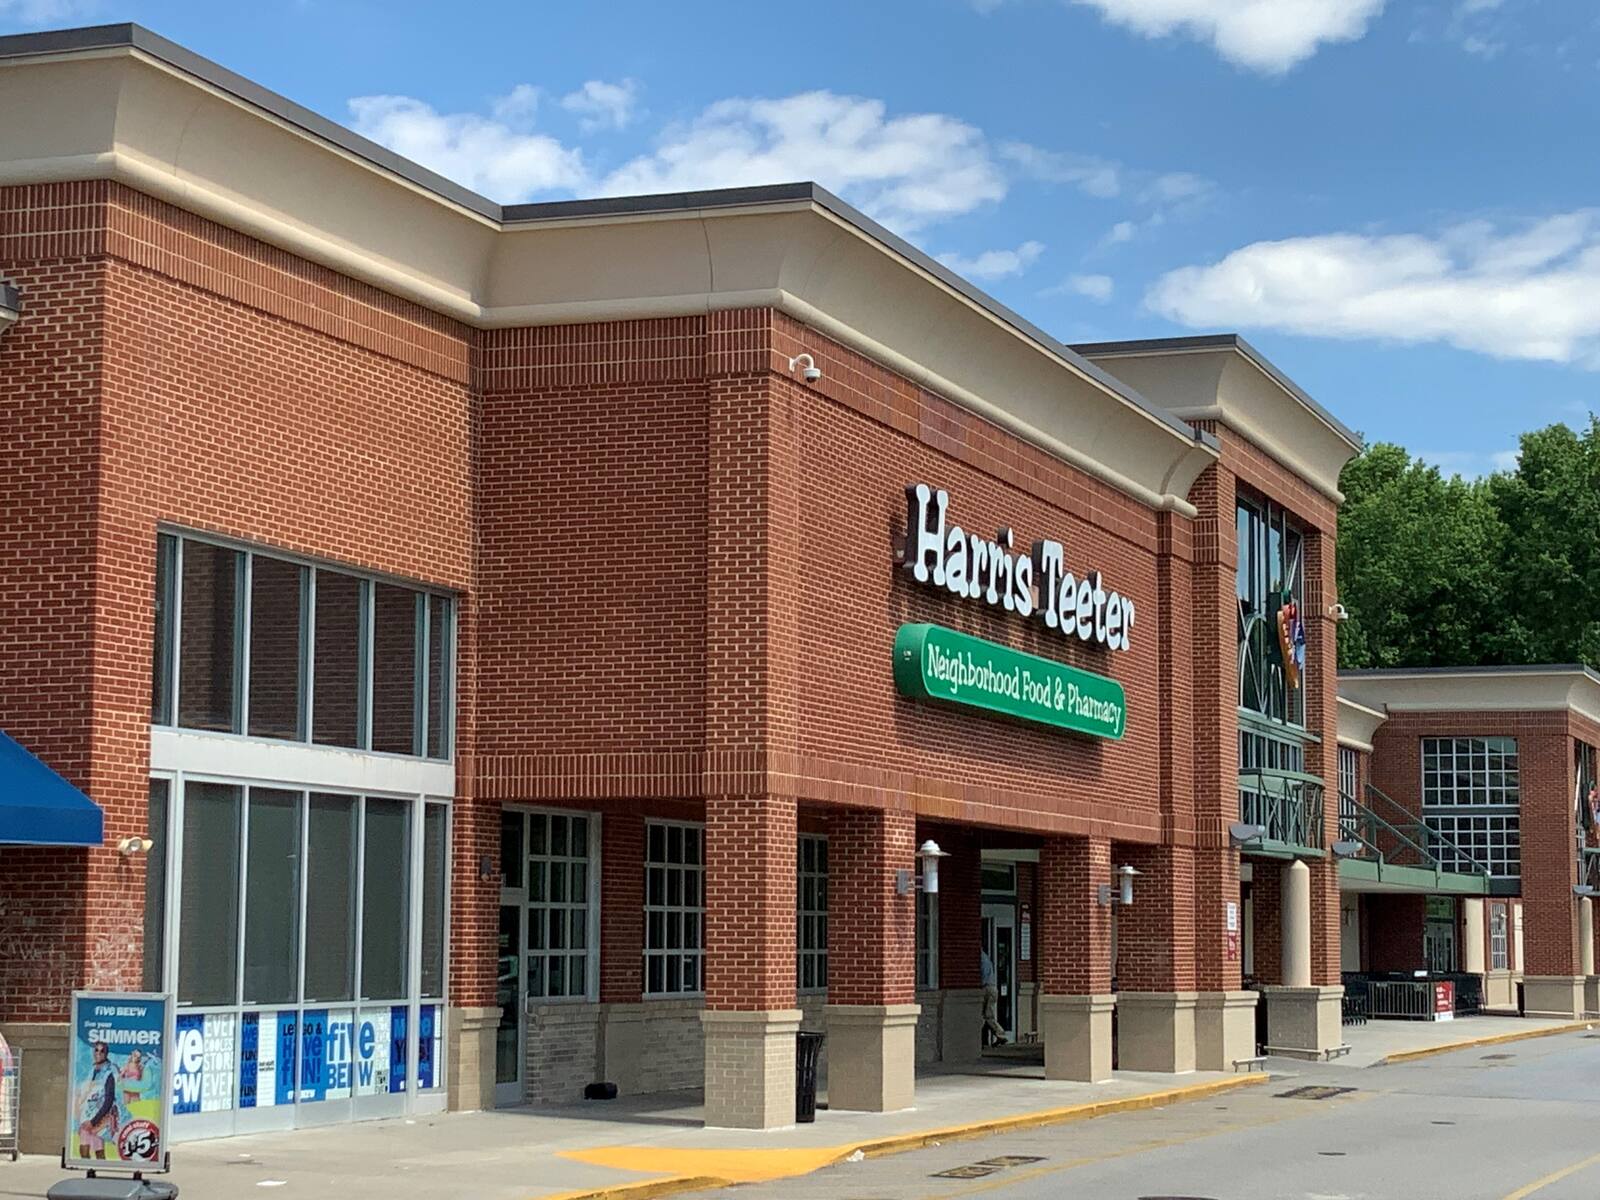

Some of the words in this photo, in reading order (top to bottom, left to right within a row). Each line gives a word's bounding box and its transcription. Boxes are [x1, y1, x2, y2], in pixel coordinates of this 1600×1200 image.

[912, 484, 1033, 616] Harris
[1042, 540, 1135, 651] Teeter
[927, 643, 1020, 699] Neighborhood
[1023, 670, 1051, 709] Food
[1054, 677, 1066, 710] &
[1067, 682, 1122, 734] Pharmacy
